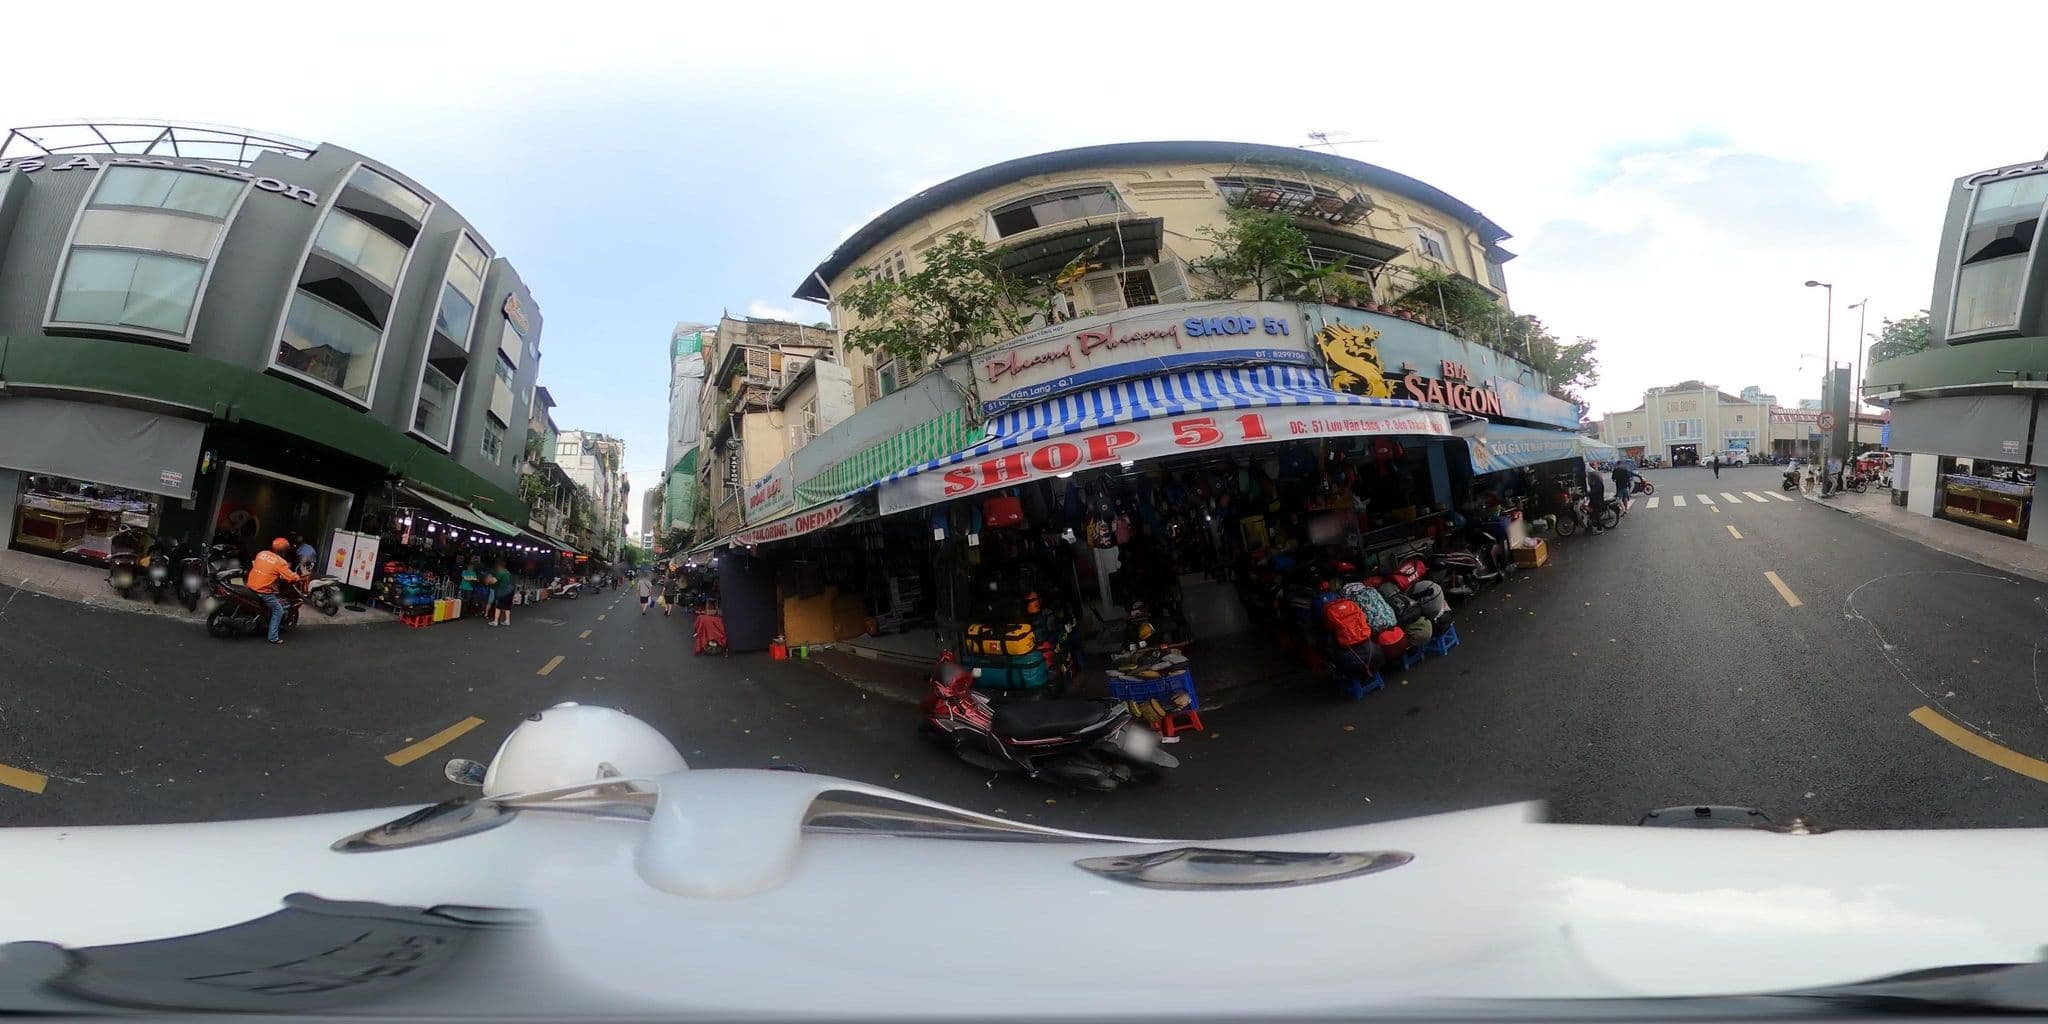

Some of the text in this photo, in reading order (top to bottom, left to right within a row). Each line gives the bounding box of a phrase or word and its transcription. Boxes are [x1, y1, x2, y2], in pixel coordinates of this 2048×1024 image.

[1184, 316, 1290, 337] SHOP 51
[1440, 360, 1470, 381] BIA
[988, 402, 998, 411] 51
[1010, 390, 1029, 399] Văn
[1030, 385, 1052, 396] Lang
[1404, 371, 1504, 417] SAIGON
[1311, 420, 1323, 432] 51
[943, 413, 1272, 497] SHOP 51
[730, 456, 738, 482] TATTOO
[752, 522, 788, 541] TAILORING
[795, 505, 843, 534] ONEDAY
